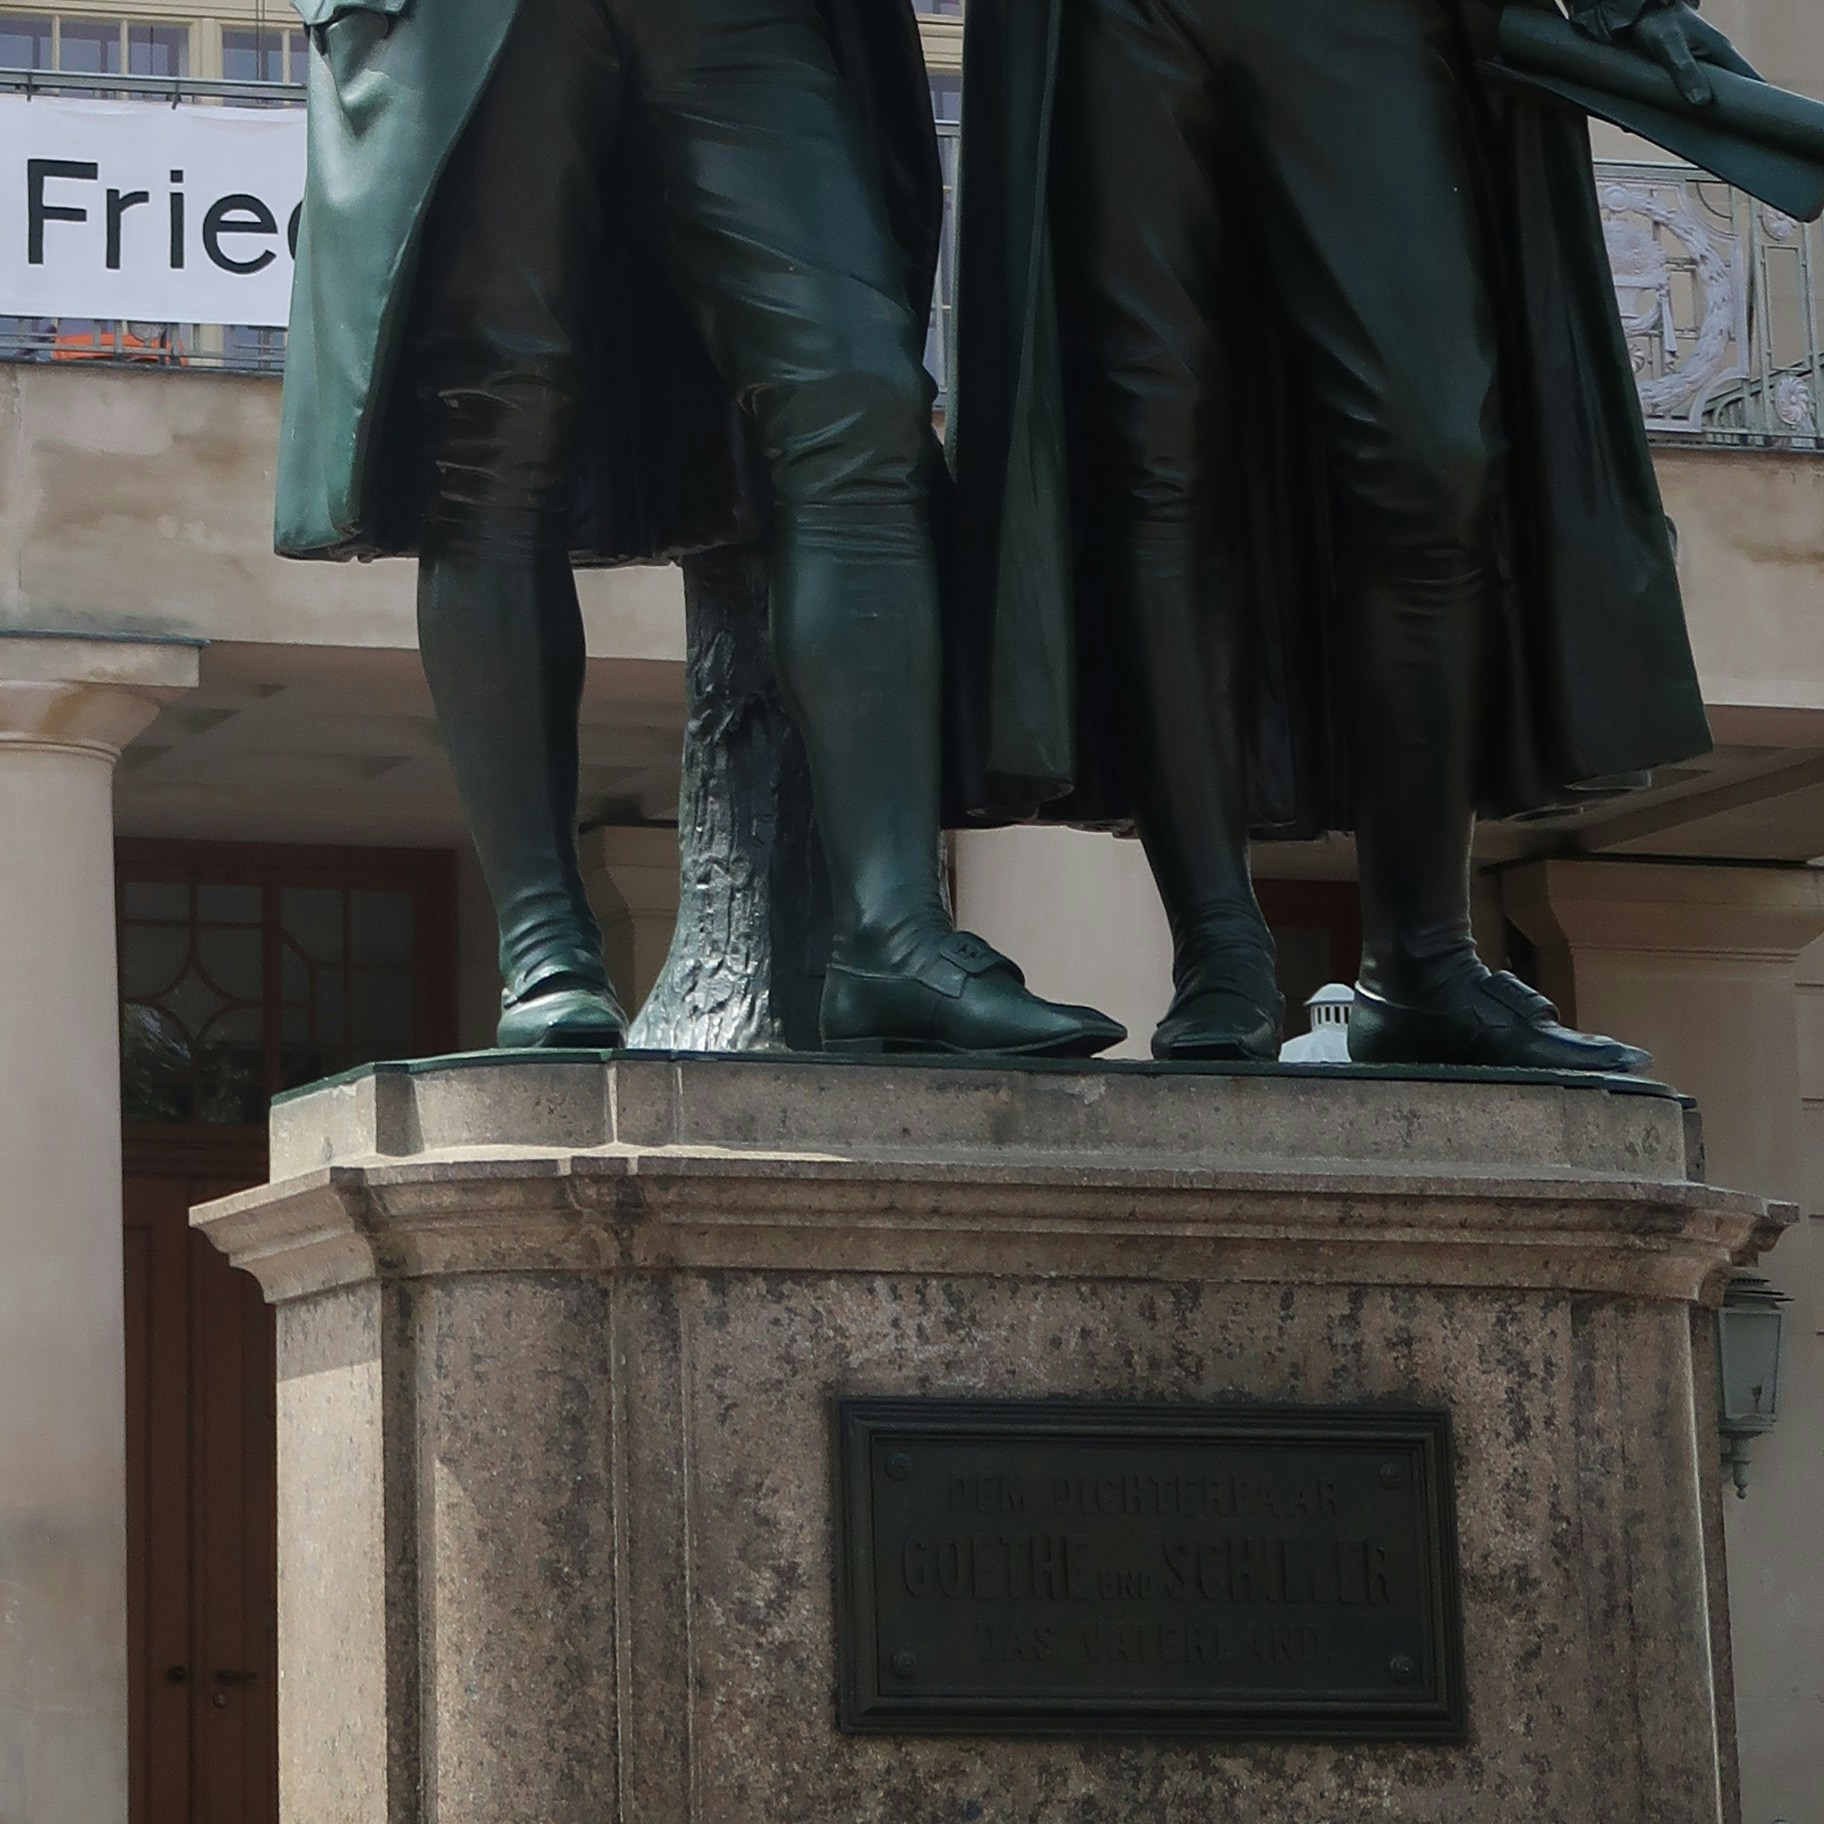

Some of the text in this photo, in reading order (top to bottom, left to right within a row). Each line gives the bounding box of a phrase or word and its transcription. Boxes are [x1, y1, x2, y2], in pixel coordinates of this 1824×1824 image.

[948, 1470, 1343, 1518] DEM DICHTERPAAR
[900, 1532, 1393, 1607] GOETHE UND SCHILLER
[975, 1621, 1052, 1663] DAS
